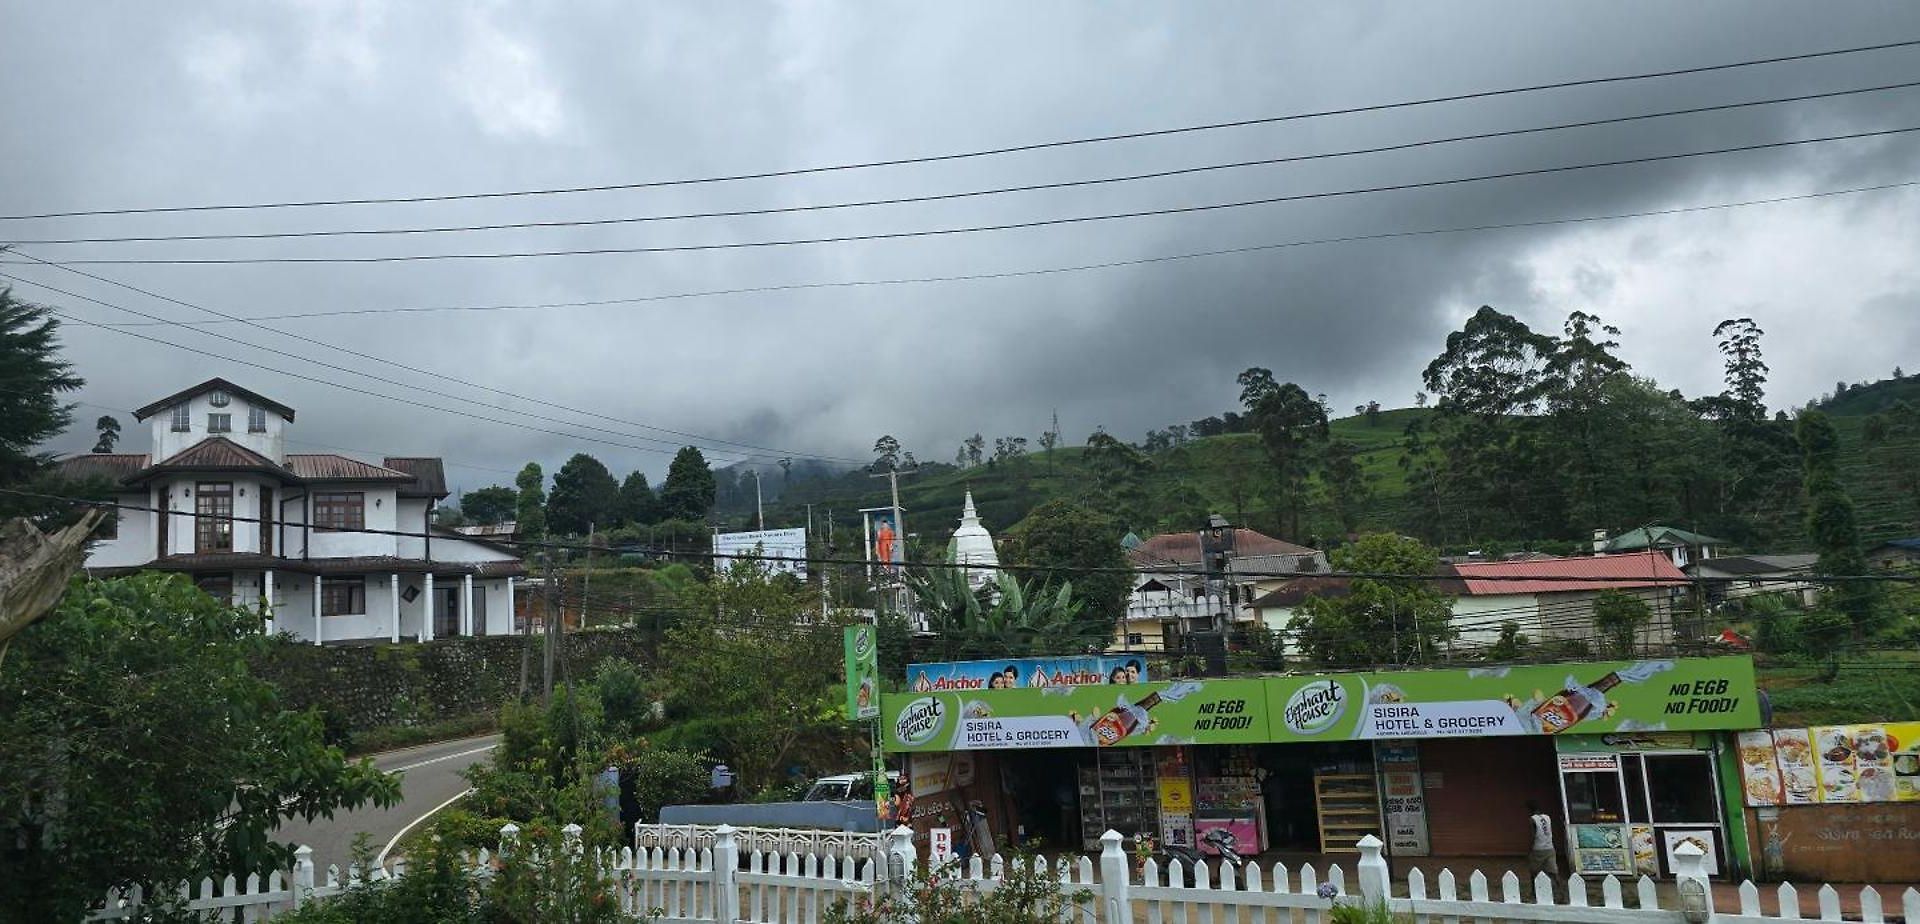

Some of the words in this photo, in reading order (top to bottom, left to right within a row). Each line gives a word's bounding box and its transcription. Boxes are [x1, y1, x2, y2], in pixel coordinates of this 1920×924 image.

[931, 675, 984, 690] Anchor
[1050, 671, 1103, 686] Anchor
[1669, 682, 1690, 696] NO
[1692, 679, 1728, 696] EGB
[1198, 703, 1215, 714] NO
[1216, 699, 1245, 714] EGB
[1285, 680, 1341, 724] Elephant
[1664, 700, 1685, 715] NO
[1686, 696, 1739, 714] FOOD!
[897, 696, 942, 736] Elephant
[1295, 702, 1330, 730] House
[1374, 707, 1420, 718] SISIRA
[904, 716, 932, 743] House
[966, 721, 1002, 732] SISIRA
[1194, 718, 1211, 730] NO
[1211, 715, 1254, 731] FOOD!
[1375, 719, 1419, 730] HOTEL
[1424, 718, 1433, 729] &
[1438, 716, 1505, 728] GROCERY
[967, 732, 1002, 742] HOTEL
[1006, 732, 1013, 741] &
[1016, 730, 1070, 741] GROCERY
